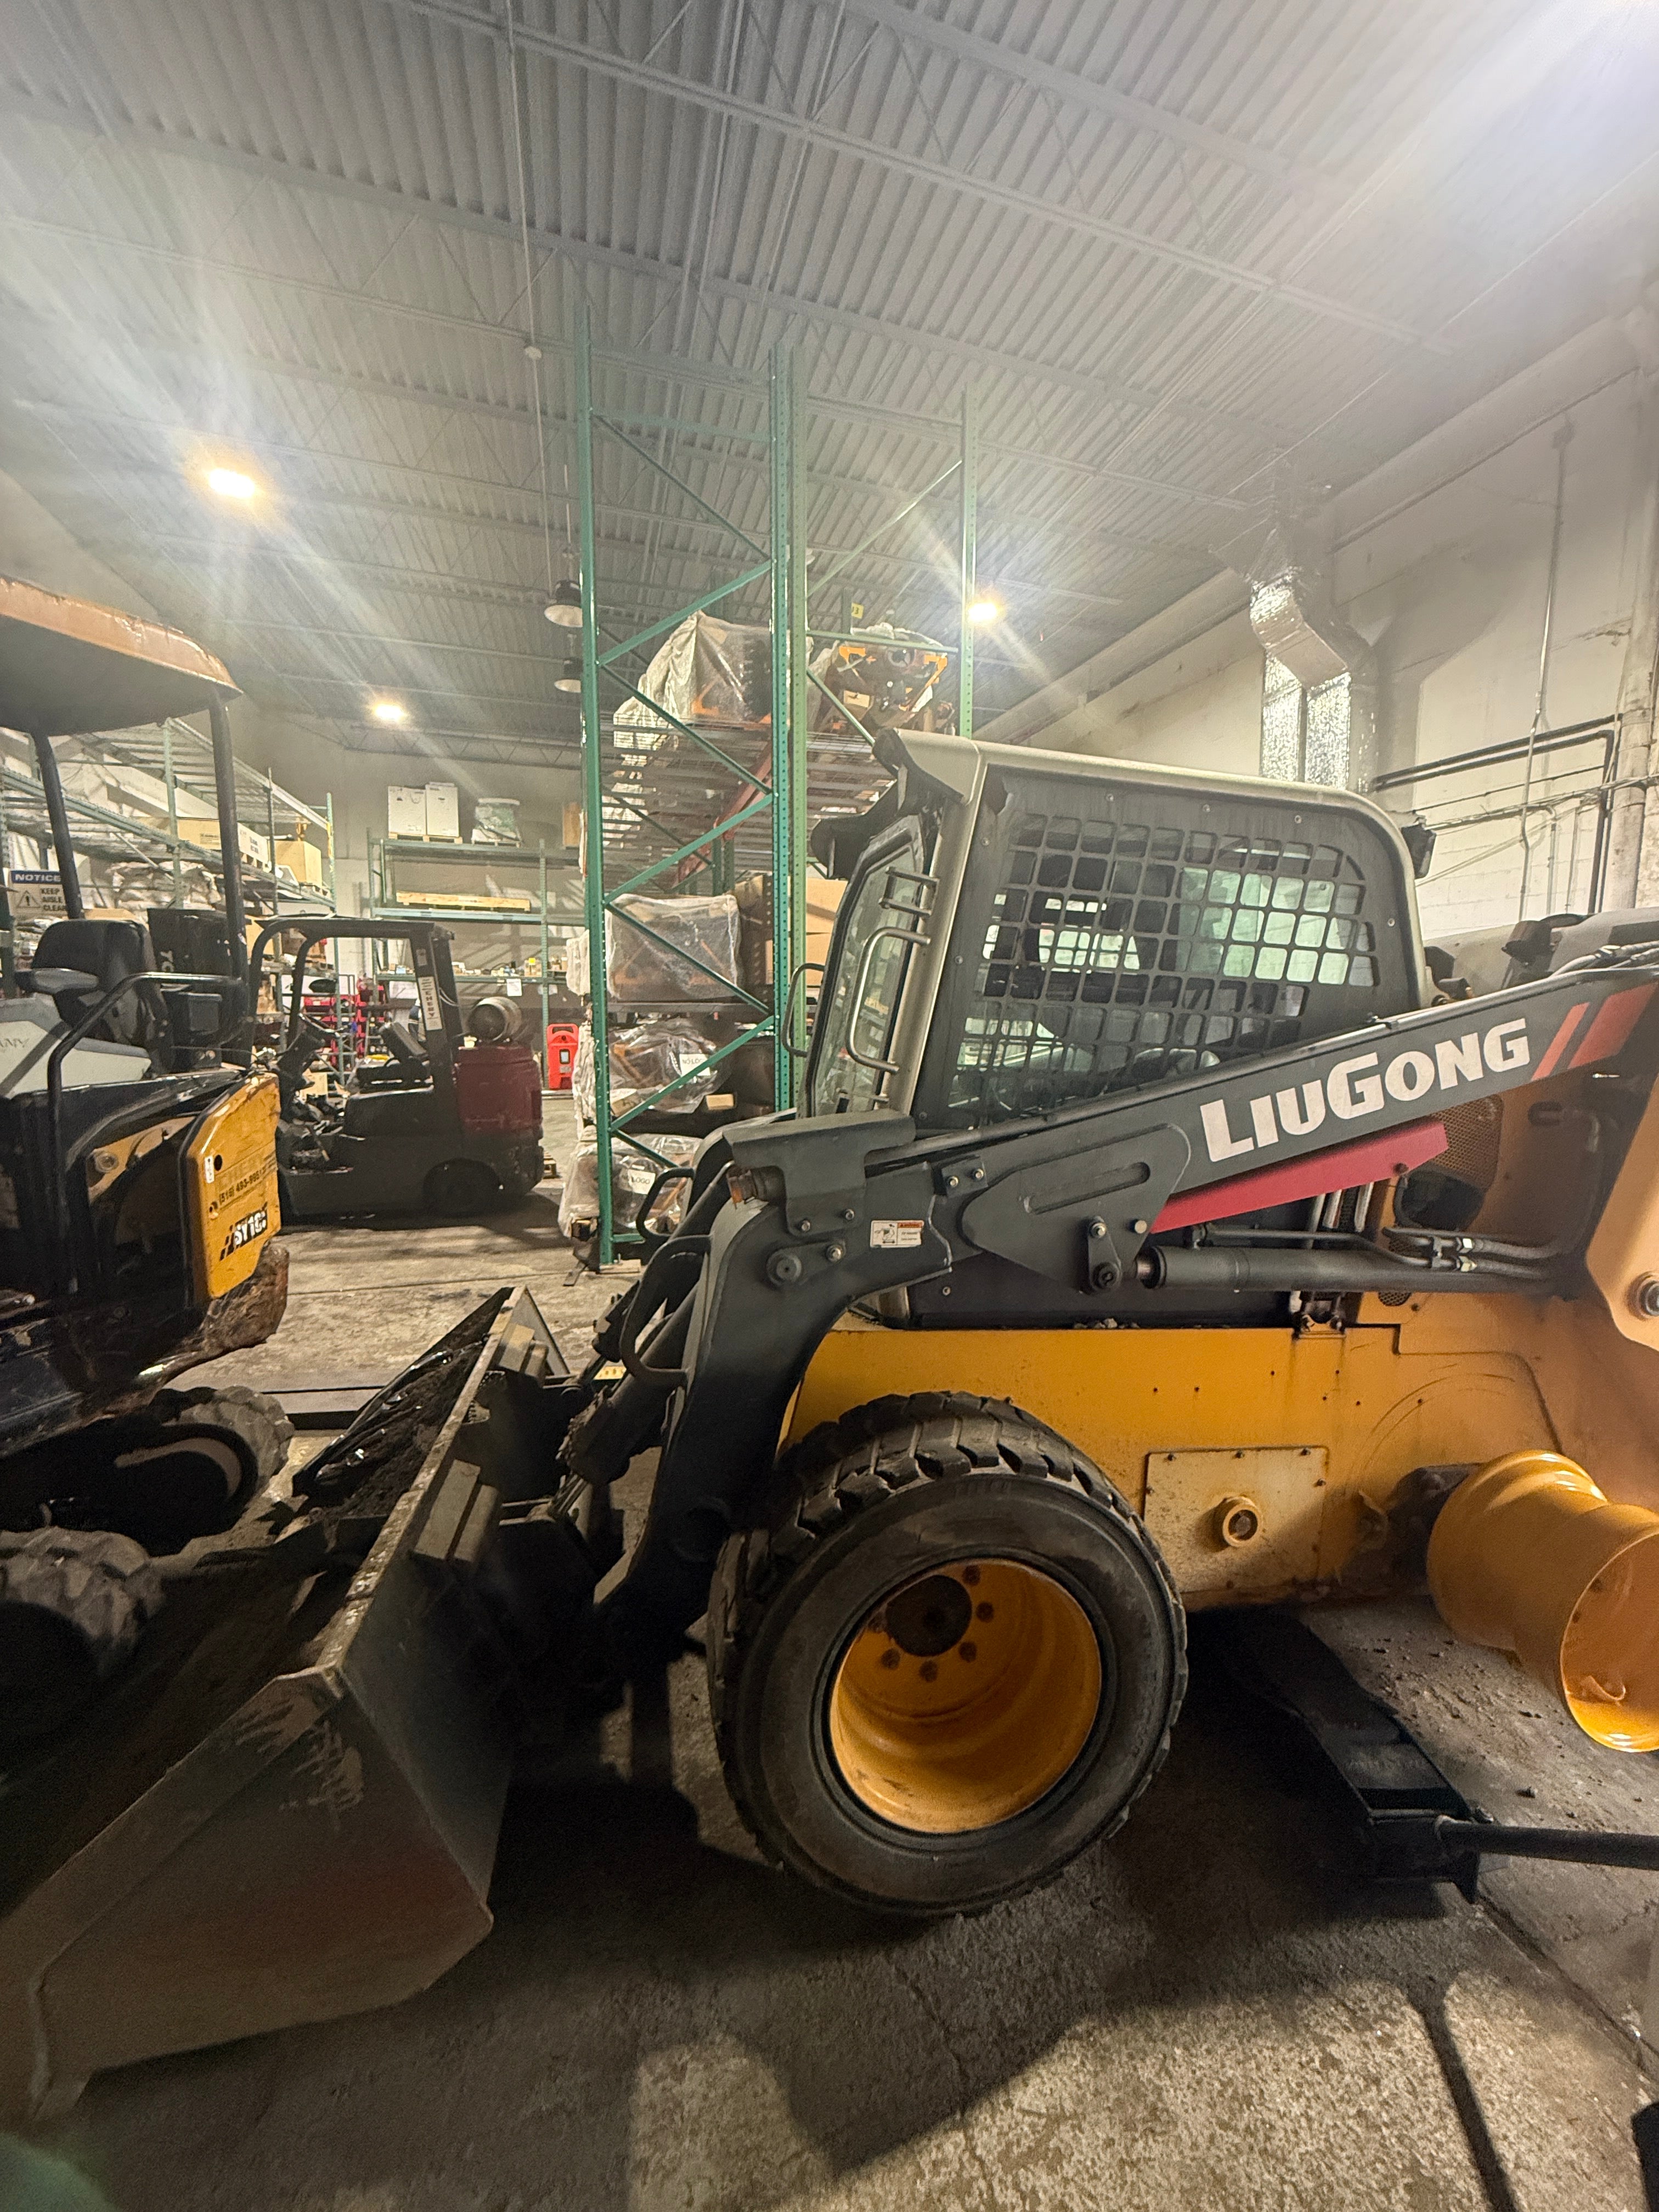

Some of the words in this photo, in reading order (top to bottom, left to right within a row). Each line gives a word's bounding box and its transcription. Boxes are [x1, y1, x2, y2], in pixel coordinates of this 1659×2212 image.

[14, 873, 61, 882] NOTICE
[1200, 1018, 1531, 1163] LIUGONG
[630, 1176, 651, 1185] LOGO
